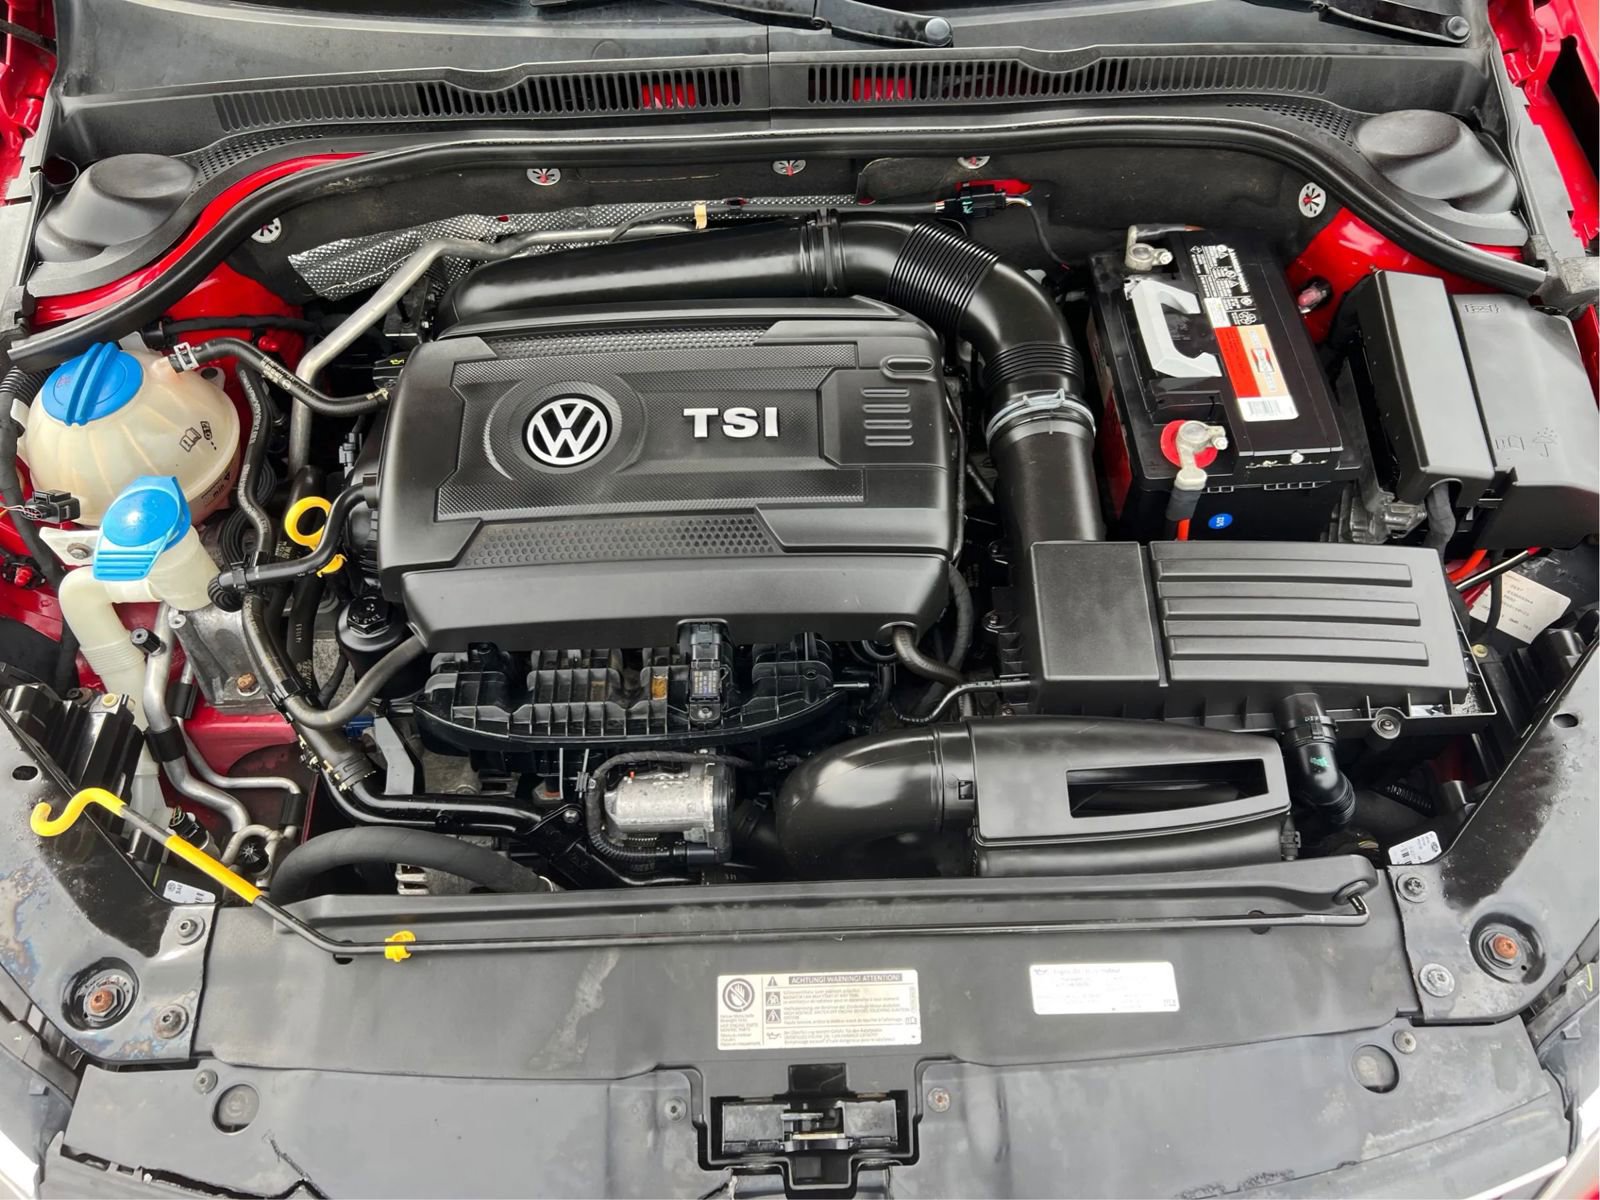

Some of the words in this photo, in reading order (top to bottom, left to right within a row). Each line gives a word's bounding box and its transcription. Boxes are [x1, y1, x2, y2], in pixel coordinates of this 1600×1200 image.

[527, 398, 608, 466] VW
[683, 406, 779, 438] TSI
[827, 975, 861, 983] WARNING!
